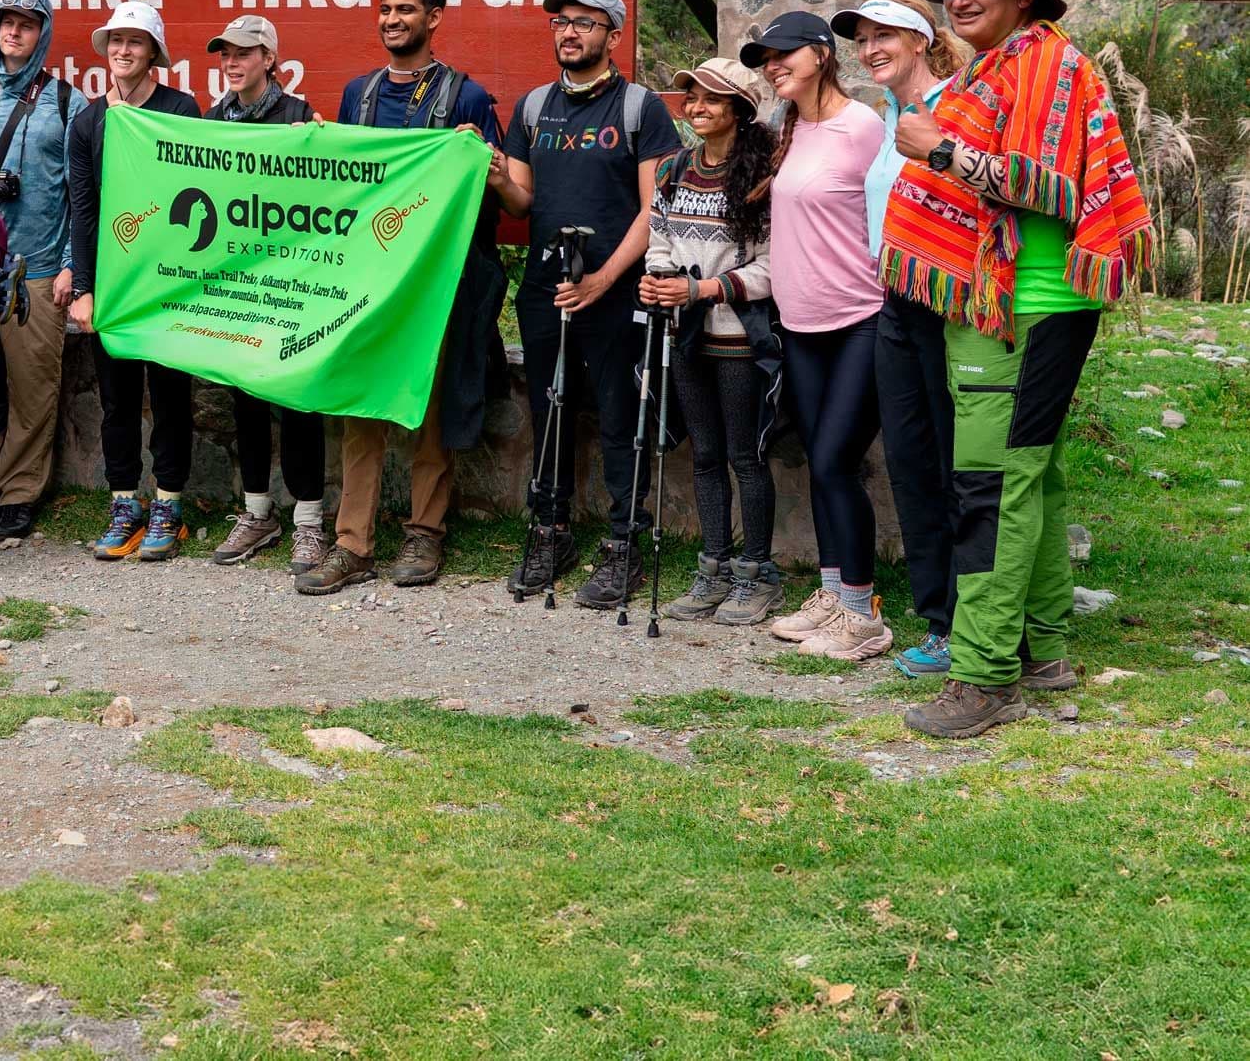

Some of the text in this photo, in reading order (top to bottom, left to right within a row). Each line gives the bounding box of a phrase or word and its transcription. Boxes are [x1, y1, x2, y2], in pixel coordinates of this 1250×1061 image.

[156, 139, 388, 185] TREKKING TO MACHUPICCHU
[226, 193, 359, 237] alpaca
[227, 241, 345, 266] EXPEDITIONS
[157, 262, 177, 277] Cusco
[202, 269, 219, 281] Inca
[220, 270, 238, 282] Trail
[330, 286, 349, 300] Treks
[203, 283, 232, 298] Rainbow
[161, 301, 301, 332] www.alpacaexpeditions.com
[279, 294, 370, 361] GREEN MACHINE
[280, 333, 297, 347] THE
